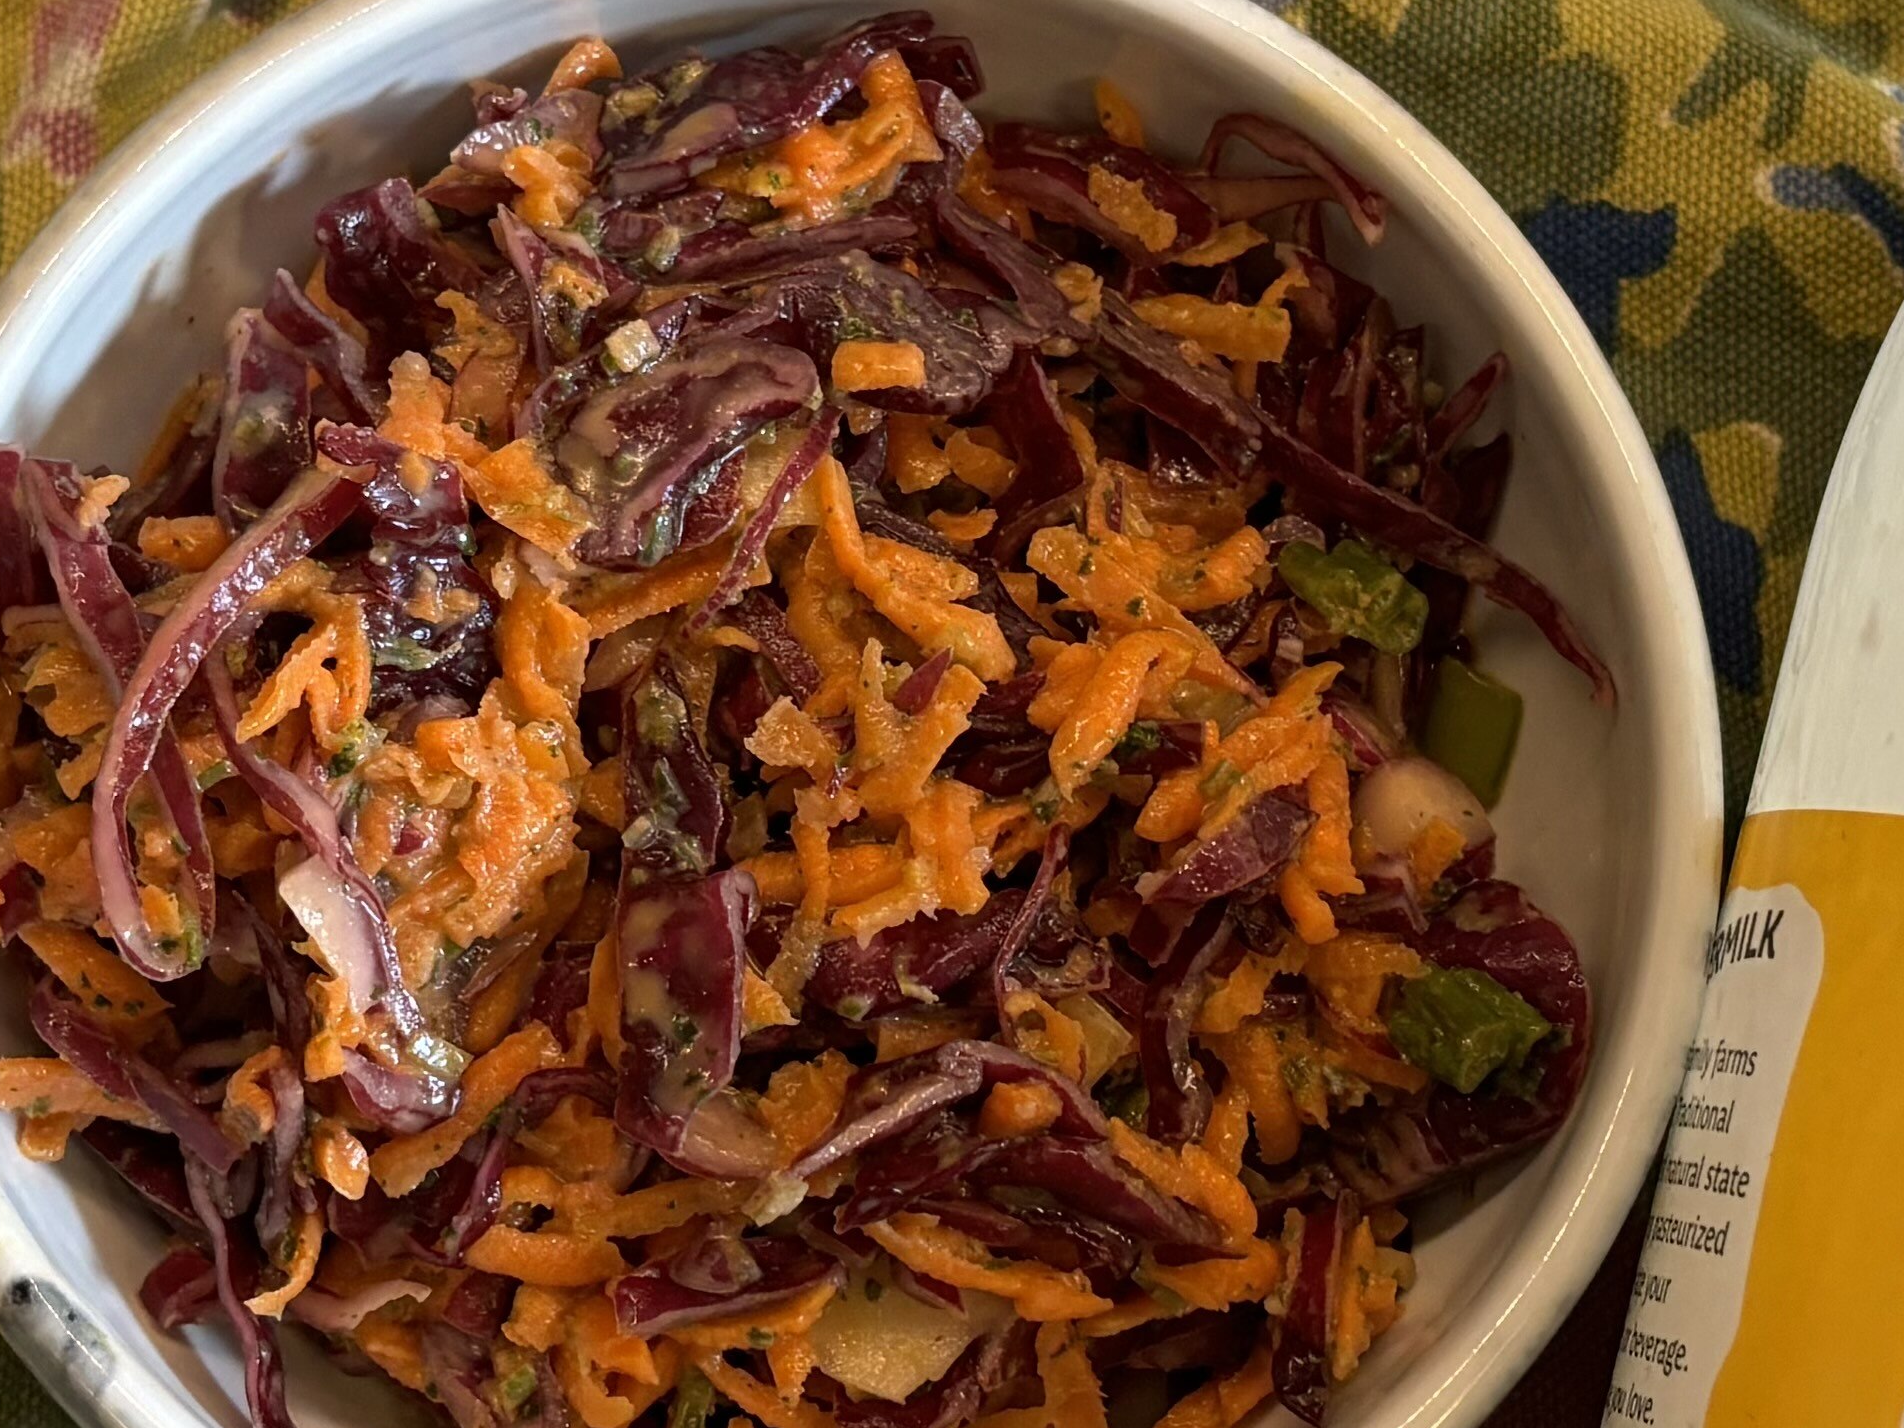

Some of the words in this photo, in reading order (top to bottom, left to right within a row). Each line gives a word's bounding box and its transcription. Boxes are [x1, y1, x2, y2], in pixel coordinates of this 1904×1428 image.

[1711, 1039, 1758, 1079] farms
[1703, 1161, 1750, 1198] state
[1629, 1321, 1688, 1377] beverage.
[1625, 1383, 1655, 1425] love.
